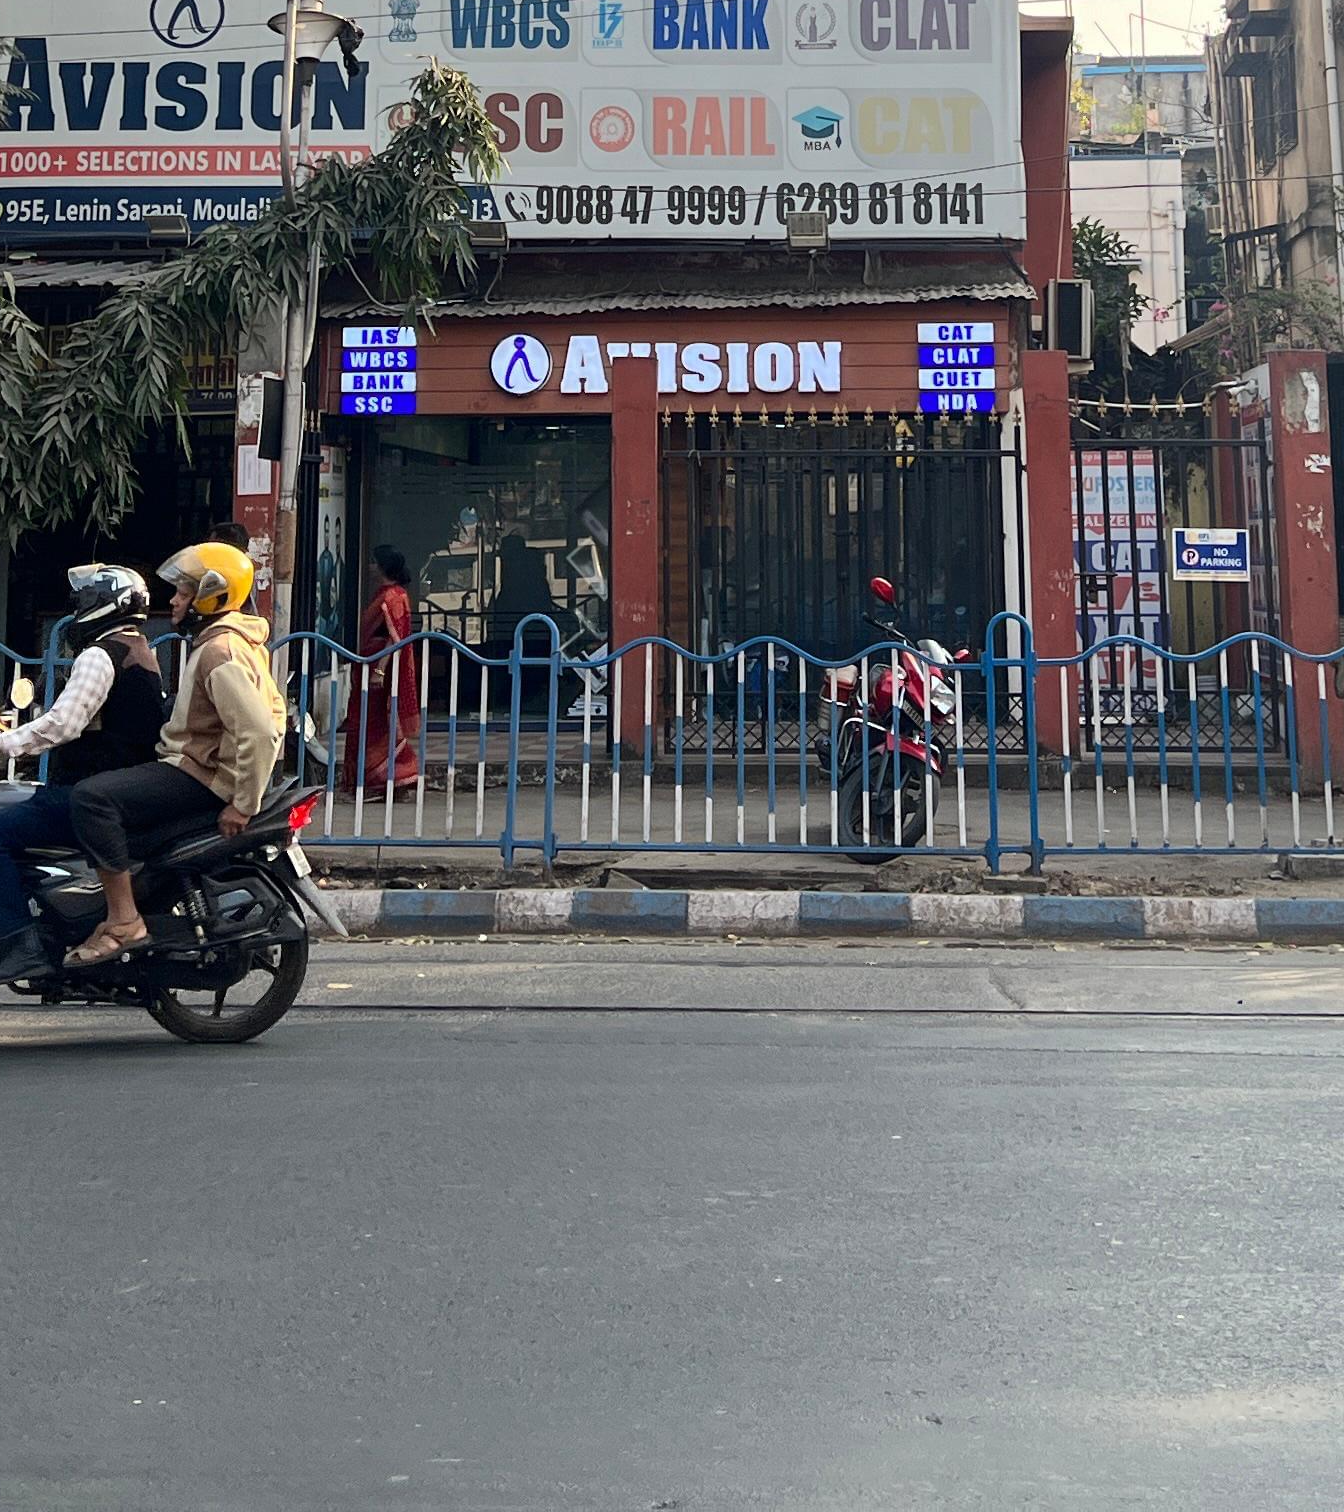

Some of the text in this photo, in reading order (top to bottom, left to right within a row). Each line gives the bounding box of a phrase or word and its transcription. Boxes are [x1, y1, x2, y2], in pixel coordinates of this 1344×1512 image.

[453, 92, 564, 154] SC
[653, 96, 776, 157] RAIL
[858, 96, 981, 155] CAT
[804, 141, 831, 151] MBA
[77, 150, 207, 172] SELECTIONS
[216, 150, 241, 171] IN
[6, 199, 49, 225] 95E,
[55, 198, 109, 221] Lenin
[536, 186, 613, 225] 9088
[620, 186, 653, 224] 47
[667, 185, 746, 225] 9999
[754, 186, 768, 225] /
[868, 181, 904, 225] 81
[913, 181, 984, 224] 8141
[362, 329, 399, 345] IAS
[938, 325, 974, 341] CAT
[350, 351, 409, 369] WBCS
[932, 347, 980, 365] CLAT
[352, 374, 404, 391] BANK
[932, 371, 982, 387] CUET
[355, 396, 393, 414] SSC
[937, 393, 978, 411] NDA
[1213, 548, 1229, 557] NO
[1200, 557, 1242, 567] PARKING
